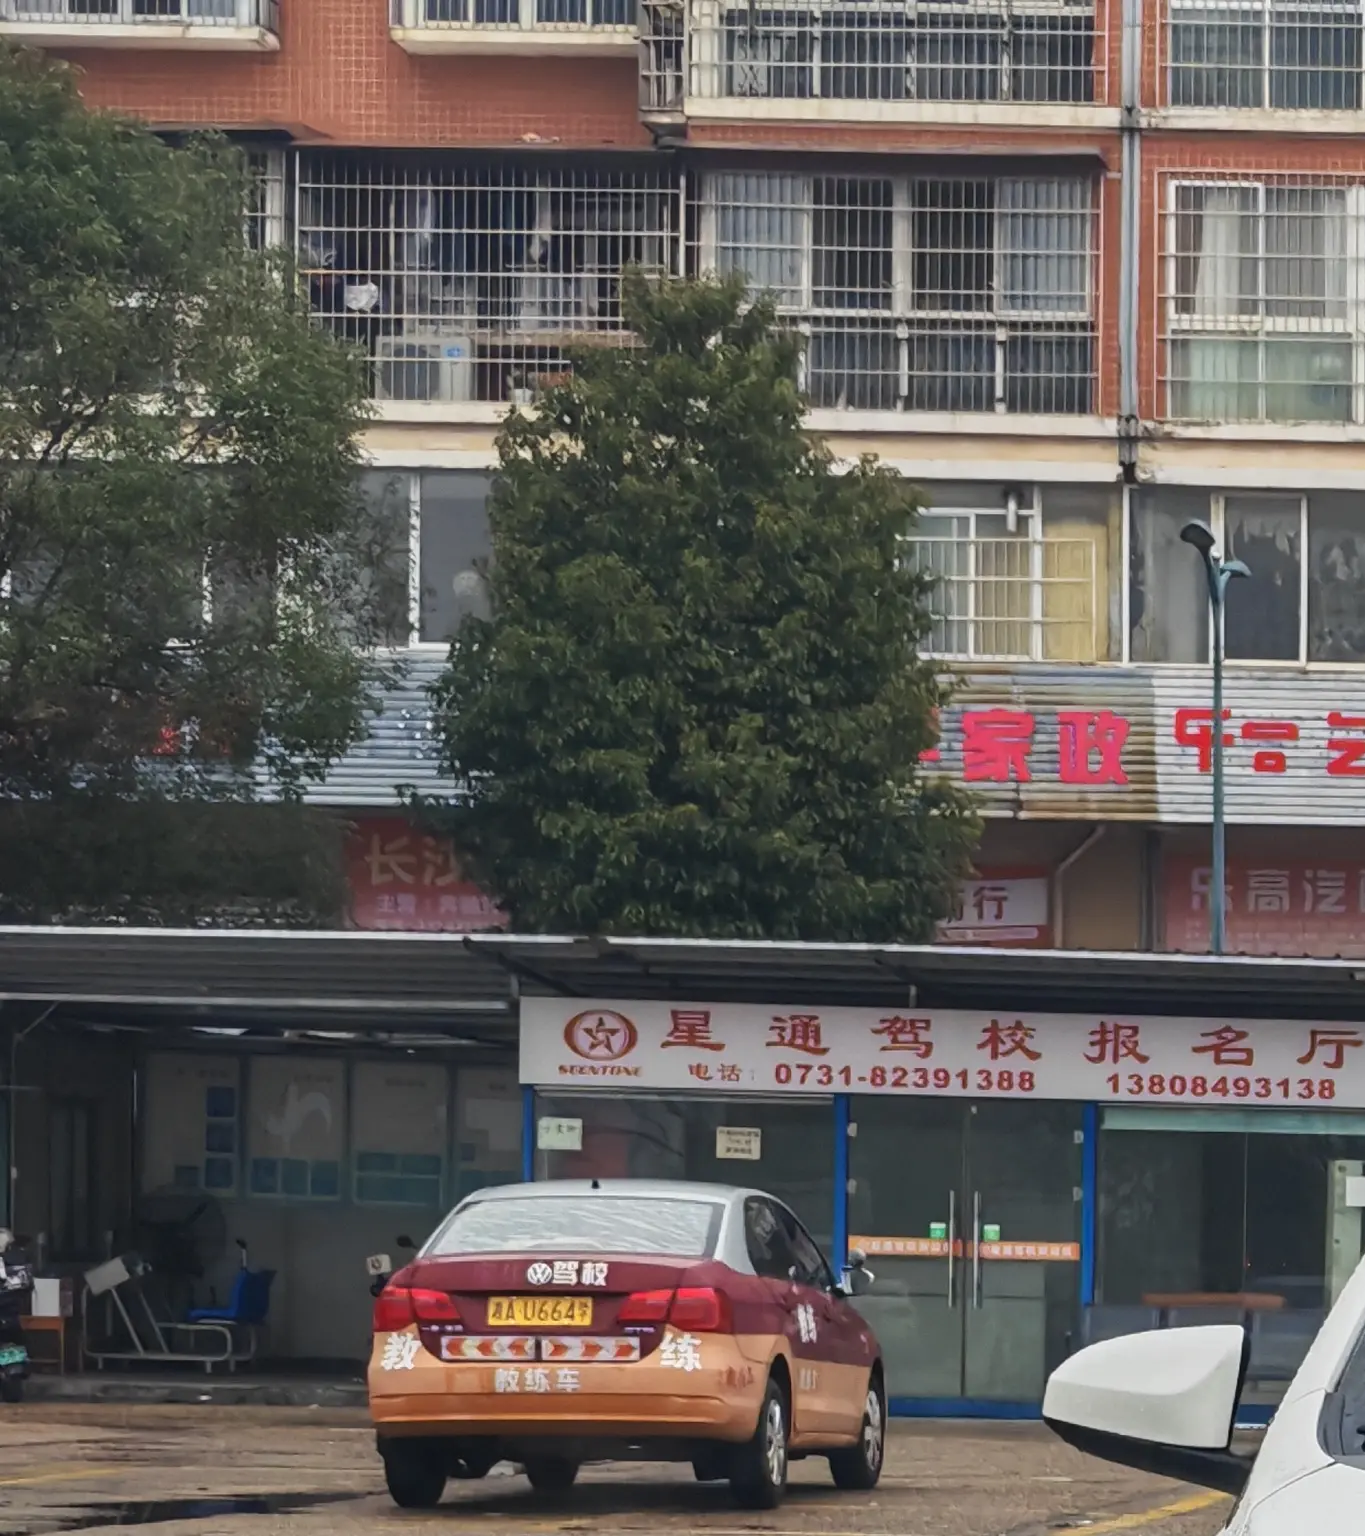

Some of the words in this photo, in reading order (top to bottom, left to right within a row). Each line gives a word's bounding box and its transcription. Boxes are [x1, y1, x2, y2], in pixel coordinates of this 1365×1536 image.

[660, 1009, 1365, 1070] 星通驾校报名厅
[774, 1062, 1036, 1093] 0731-82391388
[1106, 1073, 1336, 1100] 13808493138
[552, 1261, 608, 1287] 驾校
